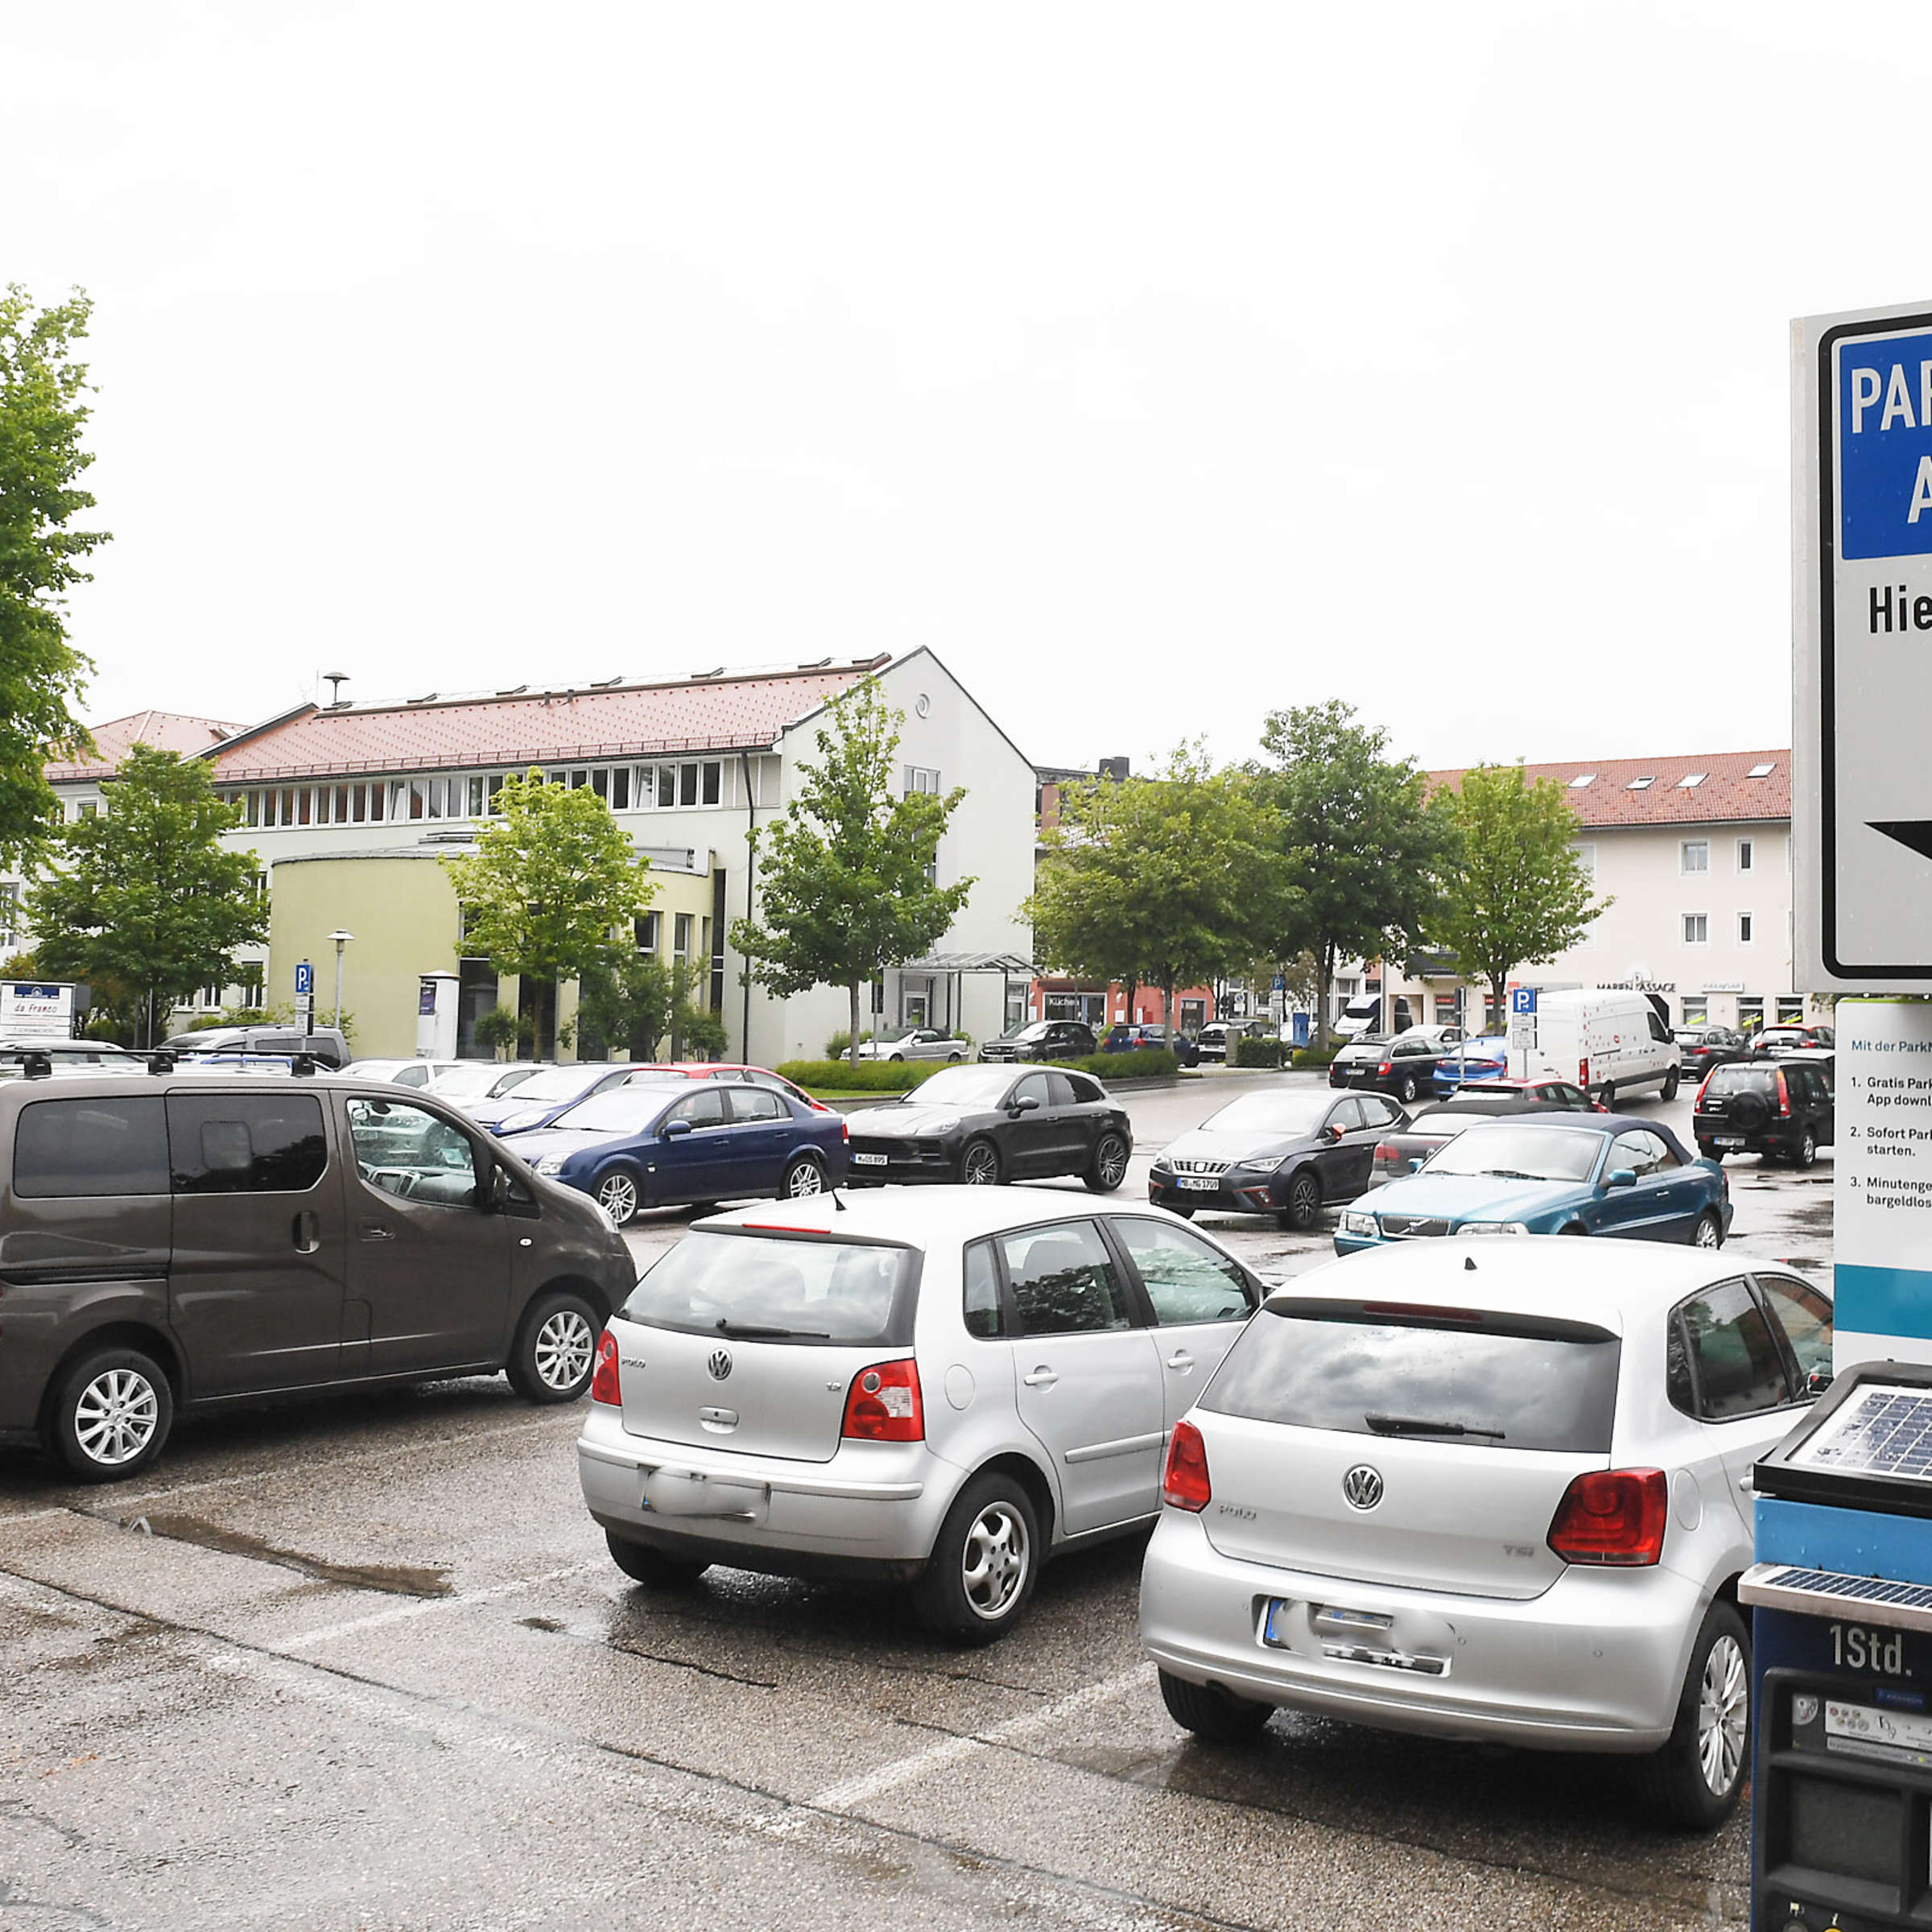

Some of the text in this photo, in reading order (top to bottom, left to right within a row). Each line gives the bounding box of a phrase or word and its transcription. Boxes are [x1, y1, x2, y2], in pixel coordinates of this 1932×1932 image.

[1869, 584, 1932, 634] Hie
[1517, 991, 1530, 1011] P
[1852, 1039, 1872, 1051] Mit
[1874, 1040, 1896, 1052] der
[1852, 1075, 1862, 1088] 1.
[1867, 1076, 1905, 1089] Gratis
[1867, 1092, 1892, 1107] App
[1850, 1126, 1932, 1140] 2. Sofort Par
[1867, 1144, 1916, 1157] starten.
[1850, 1176, 1861, 1187] 3.
[1866, 1193, 1932, 1209] bargeldlos
